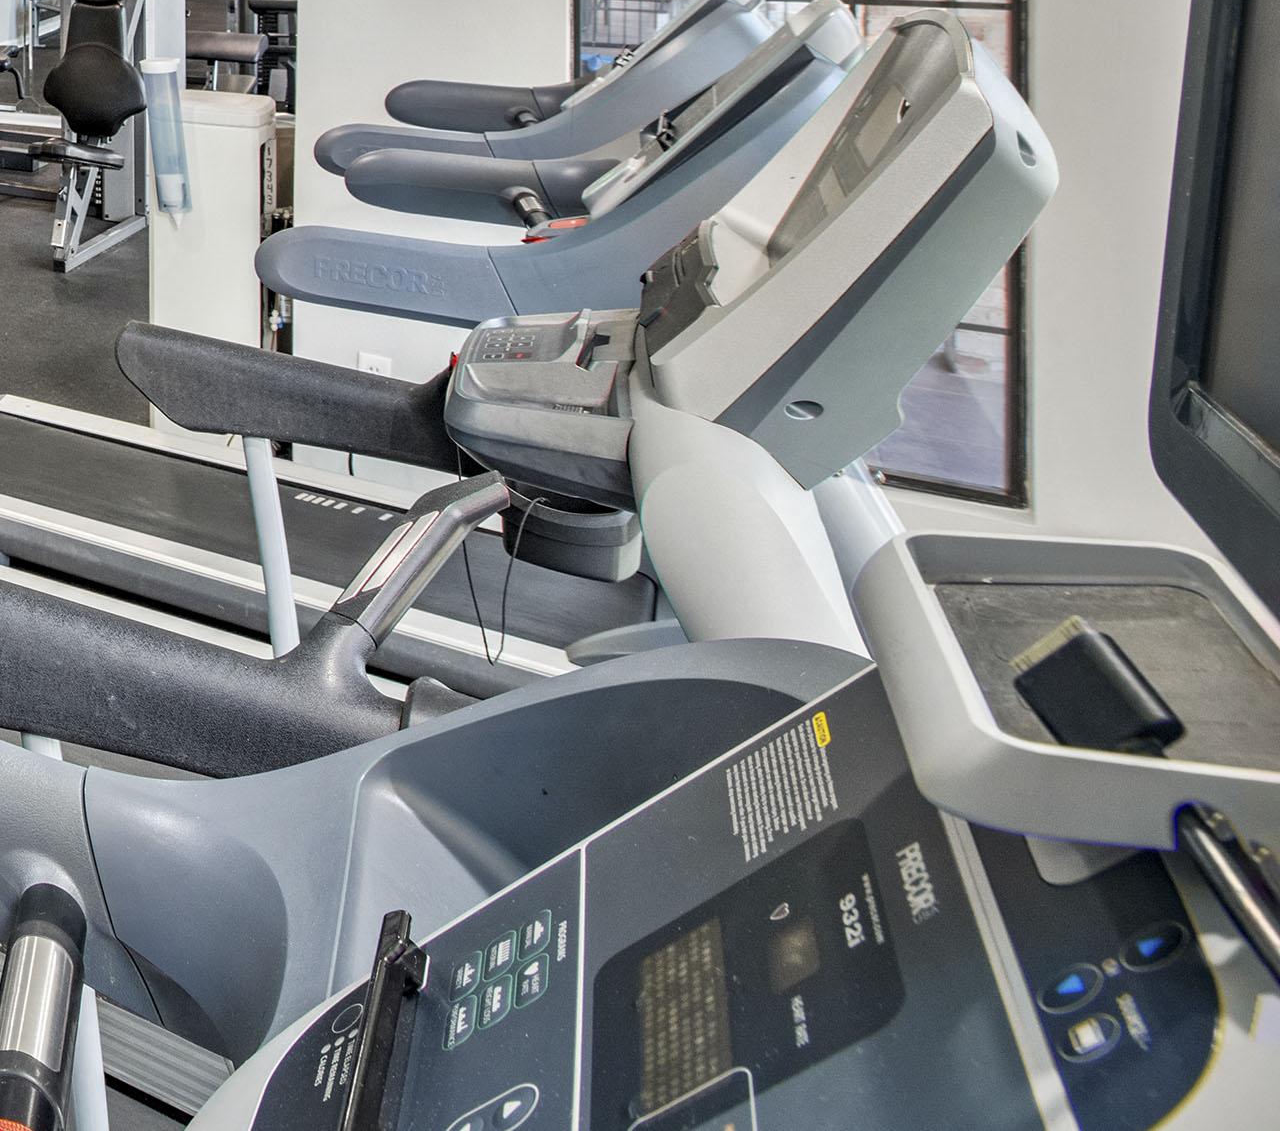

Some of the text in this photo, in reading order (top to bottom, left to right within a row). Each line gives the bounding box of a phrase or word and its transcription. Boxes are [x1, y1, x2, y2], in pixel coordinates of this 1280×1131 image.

[896, 841, 937, 917] PRECOR
[557, 920, 568, 961] PROGRAMS
[839, 892, 866, 949] 932i
[314, 1055, 328, 1087] CALORIES
[322, 1046, 342, 1102] TIME REMAINING
[339, 1055, 352, 1085] ELAPSED
